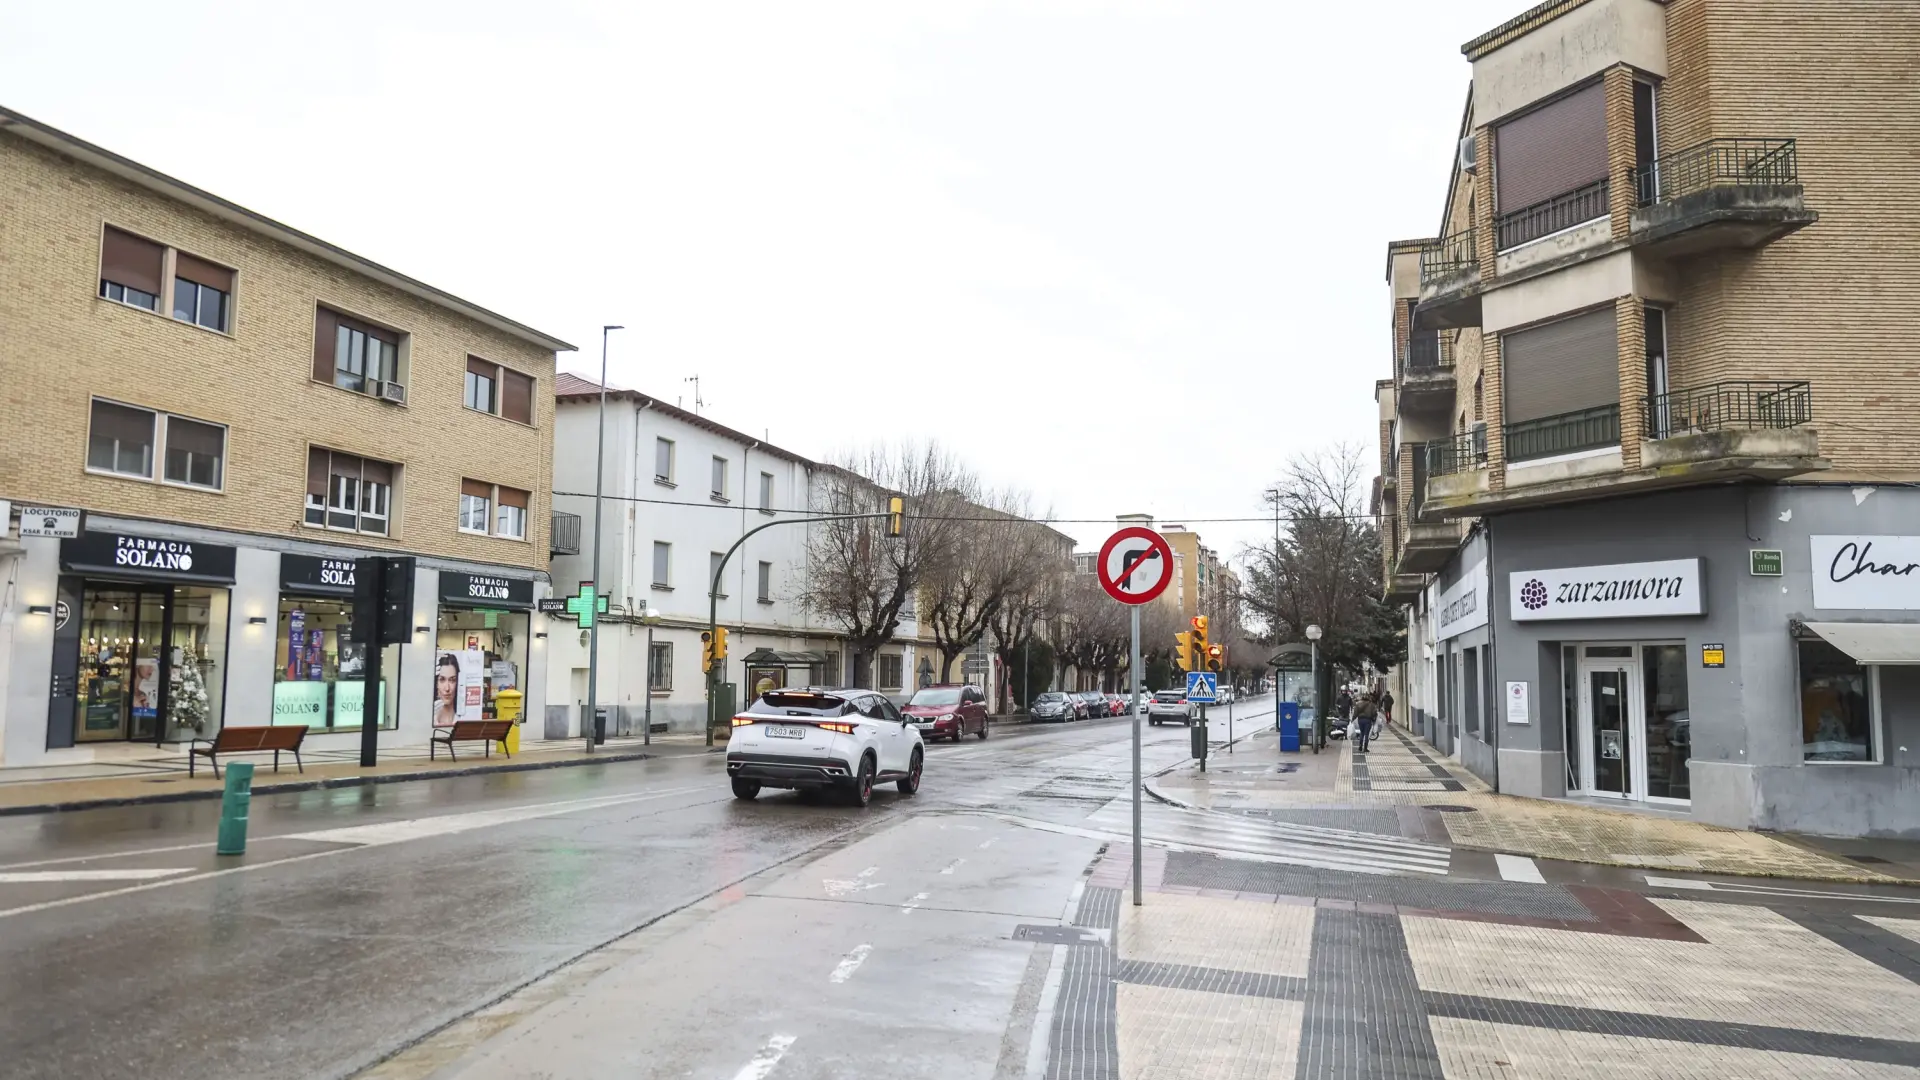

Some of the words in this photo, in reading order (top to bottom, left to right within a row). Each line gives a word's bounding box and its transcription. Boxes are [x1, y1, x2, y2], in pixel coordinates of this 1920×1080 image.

[24, 508, 79, 517] LOCUTORIO
[117, 537, 192, 554] FARMACIA
[116, 549, 192, 570] SOLANO
[321, 570, 355, 585] SOLA
[469, 576, 509, 587] FARMACIA
[469, 584, 509, 599] SOLANO
[1555, 577, 1683, 605] zarzamora
[770, 727, 787, 736] 7503
[789, 728, 802, 736] MRB
